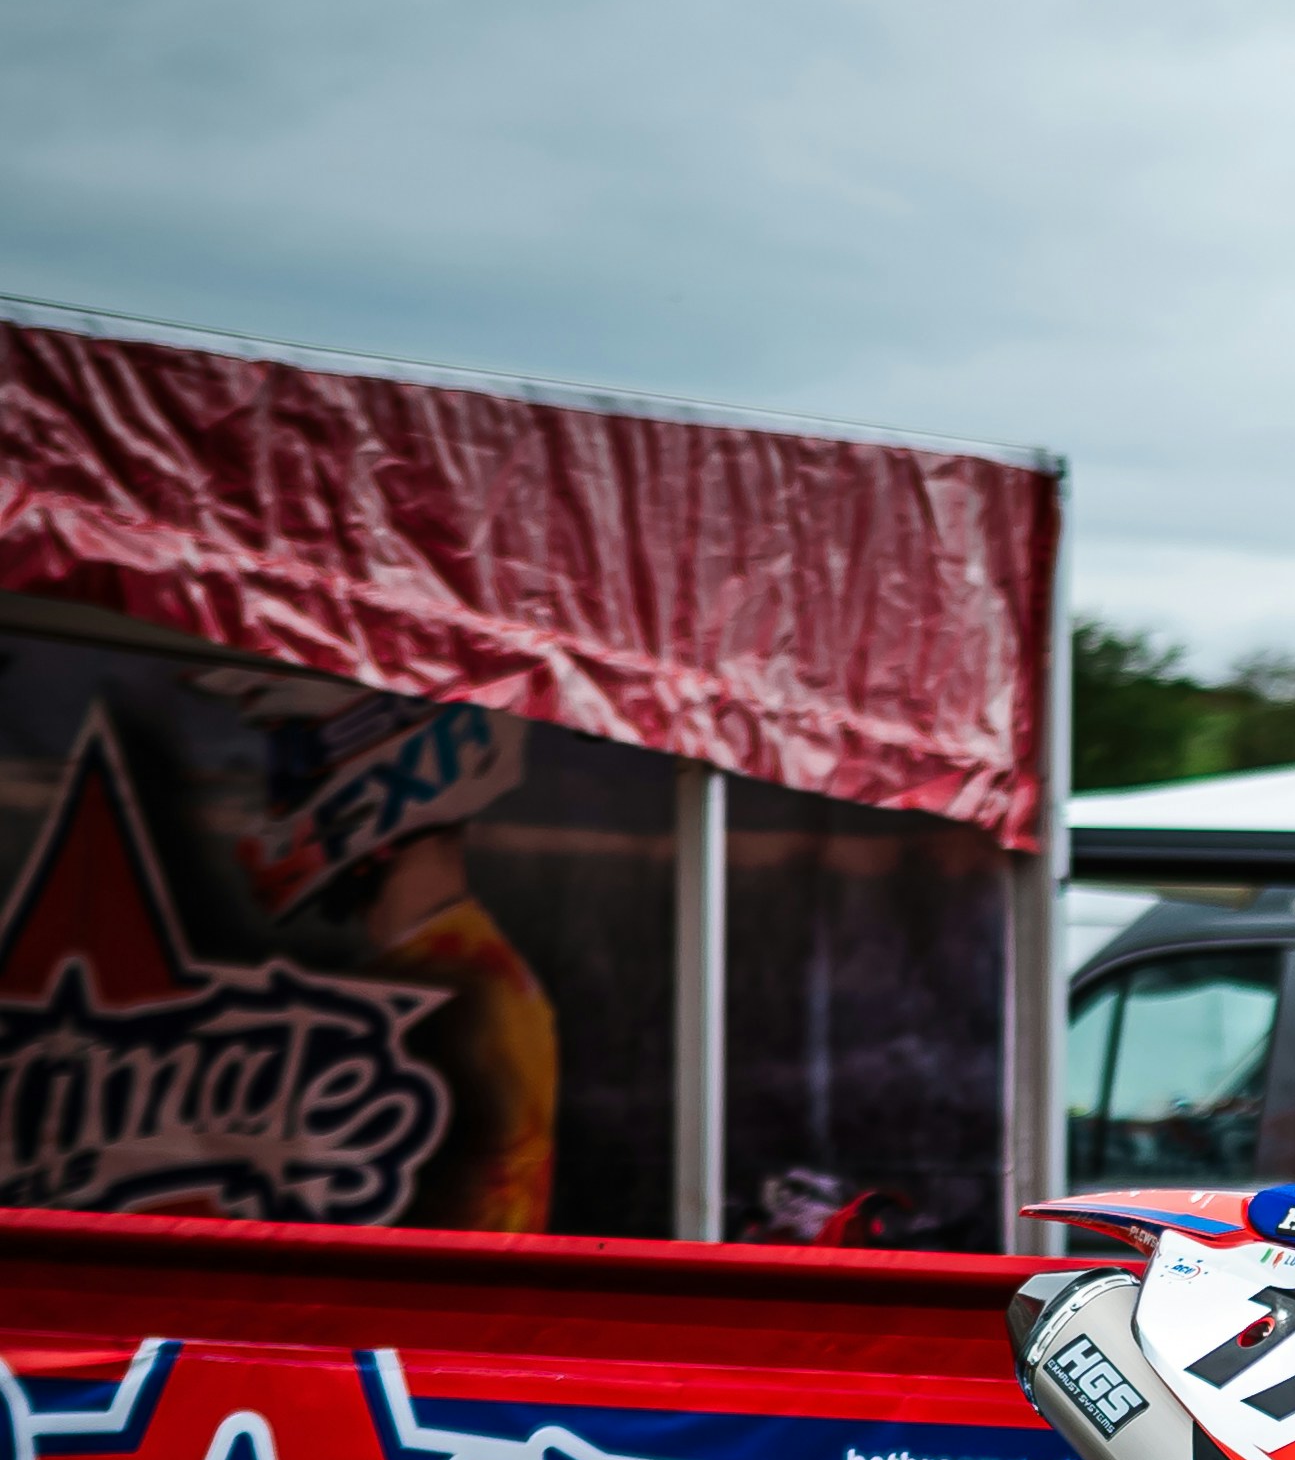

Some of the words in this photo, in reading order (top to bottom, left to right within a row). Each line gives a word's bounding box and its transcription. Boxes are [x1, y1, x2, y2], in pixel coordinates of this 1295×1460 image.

[1046, 1359, 1081, 1395] EXHAUST
[1078, 1393, 1116, 1434] SYSTEMS
[1057, 1339, 1143, 1423] HGS
